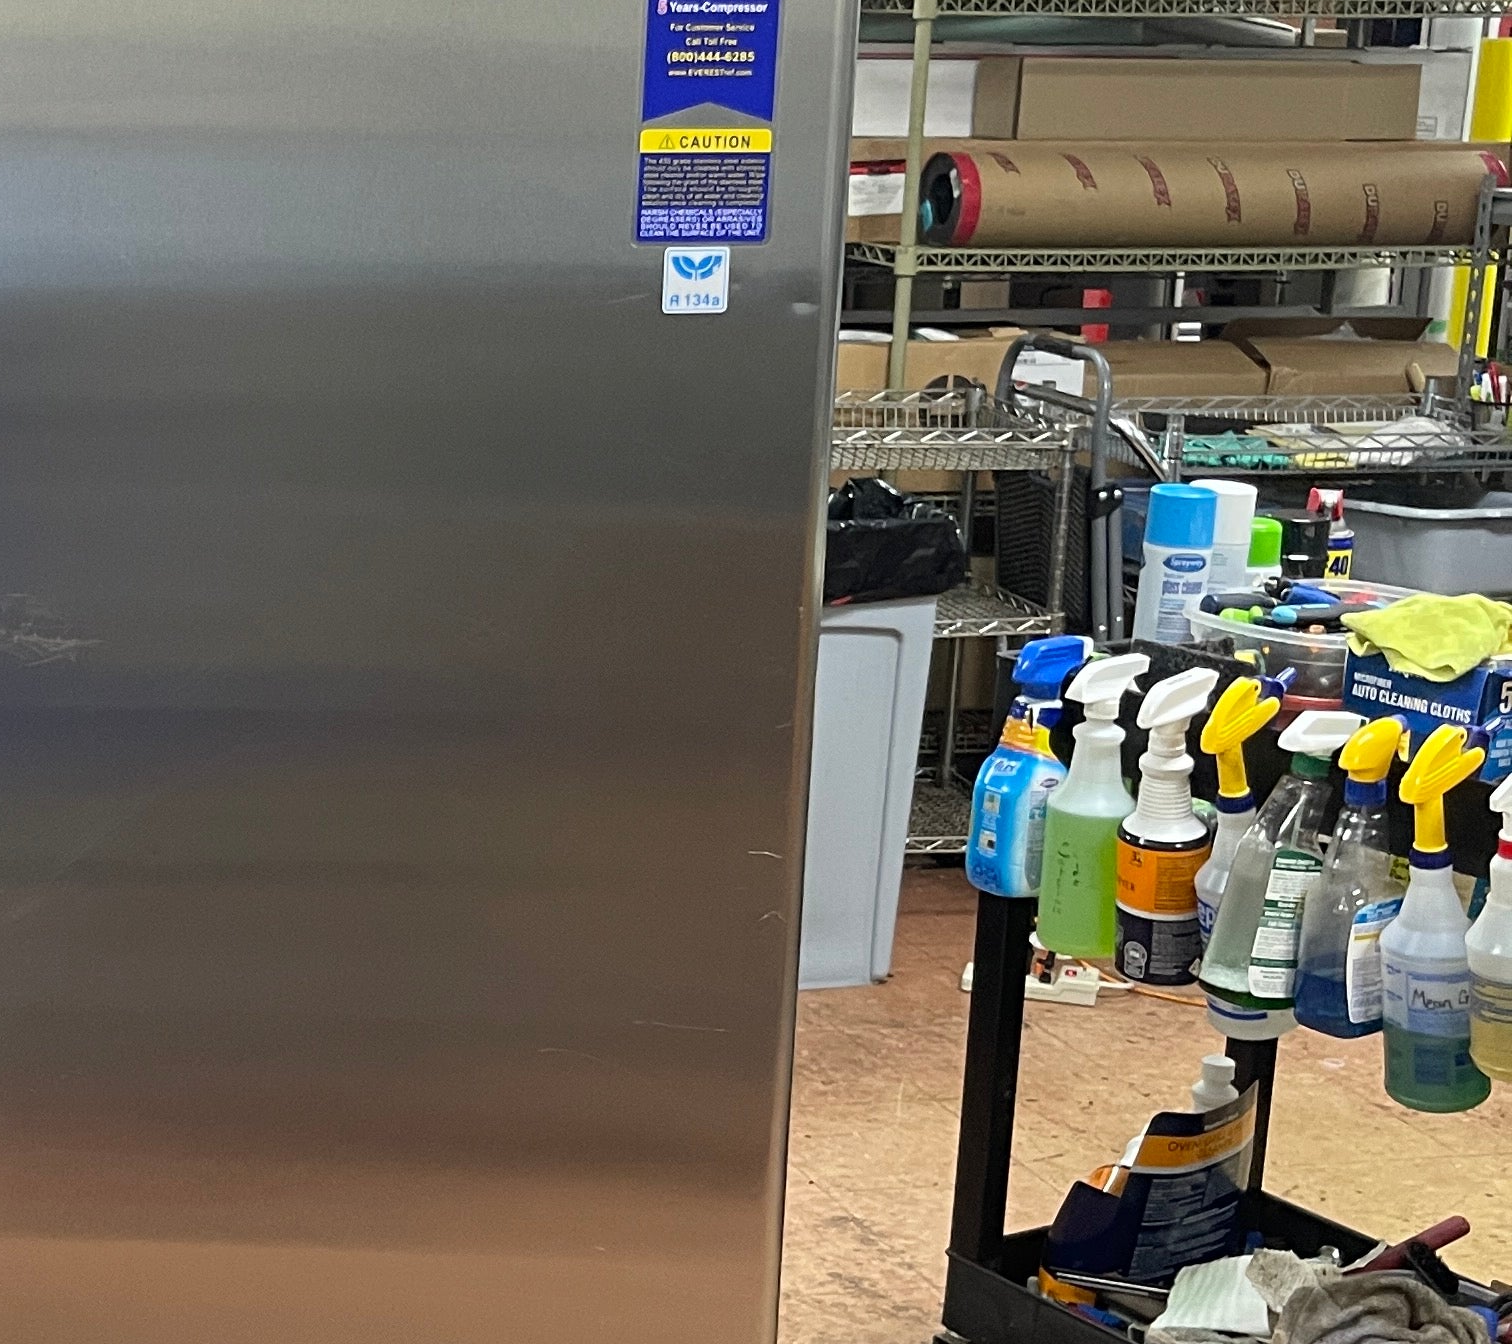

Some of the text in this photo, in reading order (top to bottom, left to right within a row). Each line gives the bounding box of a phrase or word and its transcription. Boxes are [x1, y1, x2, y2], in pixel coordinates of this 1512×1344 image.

[657, 0, 769, 15] 5 Years-Compressor
[670, 23, 755, 32] For Customer Service
[685, 38, 738, 46] Call Toll Free
[667, 51, 755, 64] (800)444-6285
[680, 136, 751, 149] CAUTION
[640, 222, 763, 230] SHOULD NEVER BE USED TO
[670, 293, 720, 307] R 134a
[1351, 683, 1472, 724] AUTO CLEANING CLOTHS
[1411, 988, 1454, 1011] Mean
